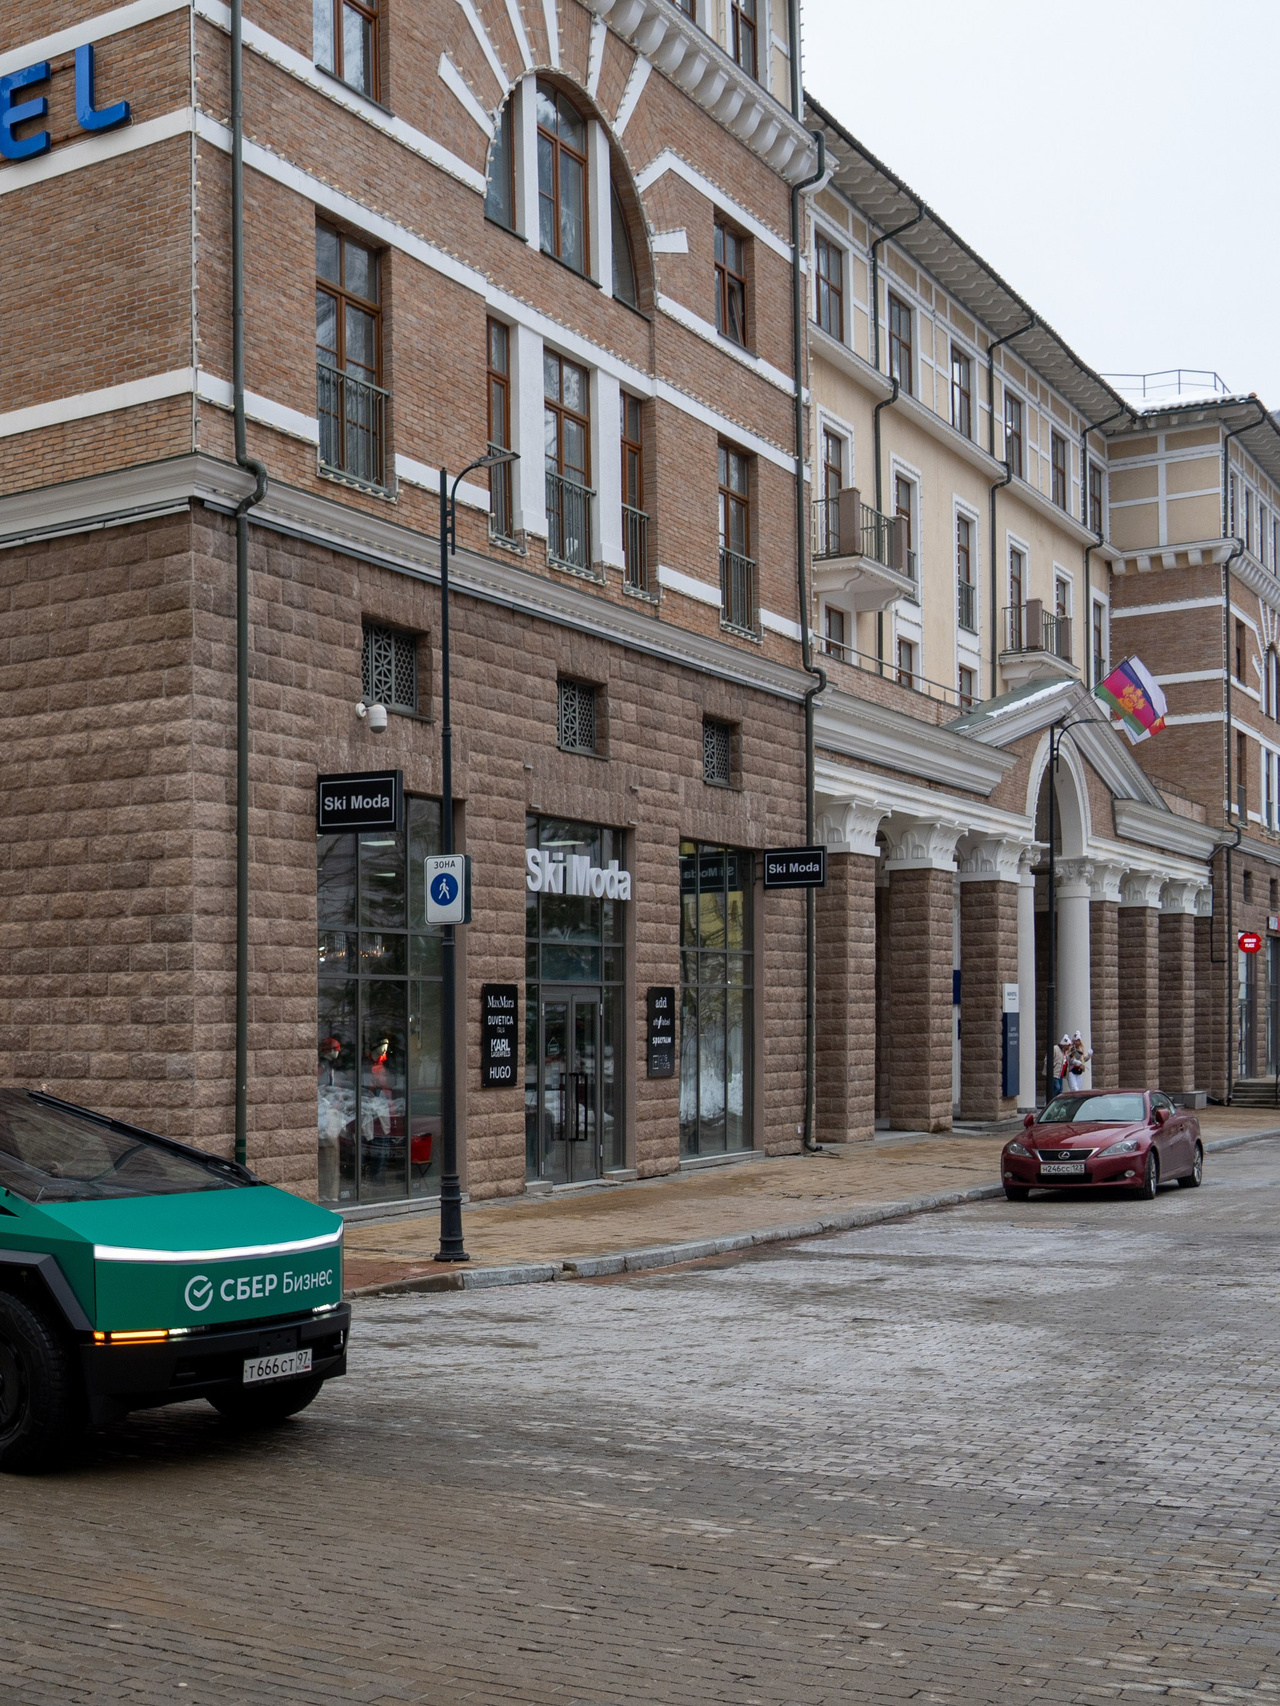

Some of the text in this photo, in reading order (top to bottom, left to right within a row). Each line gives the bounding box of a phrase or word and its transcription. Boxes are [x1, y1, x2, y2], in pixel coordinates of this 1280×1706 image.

[324, 794, 390, 811] Ski Moda
[433, 860, 456, 869] ЗОНА
[768, 862, 820, 874] Ski Moda
[525, 847, 631, 901] Ski Moda
[655, 997, 668, 1008] add
[487, 1015, 514, 1025] DUVETICA
[490, 1039, 511, 1051] KARL
[489, 1065, 511, 1079] HUGO
[220, 1268, 333, 1302] СБЕР Бизнес
[297, 1351, 308, 1366] 97
